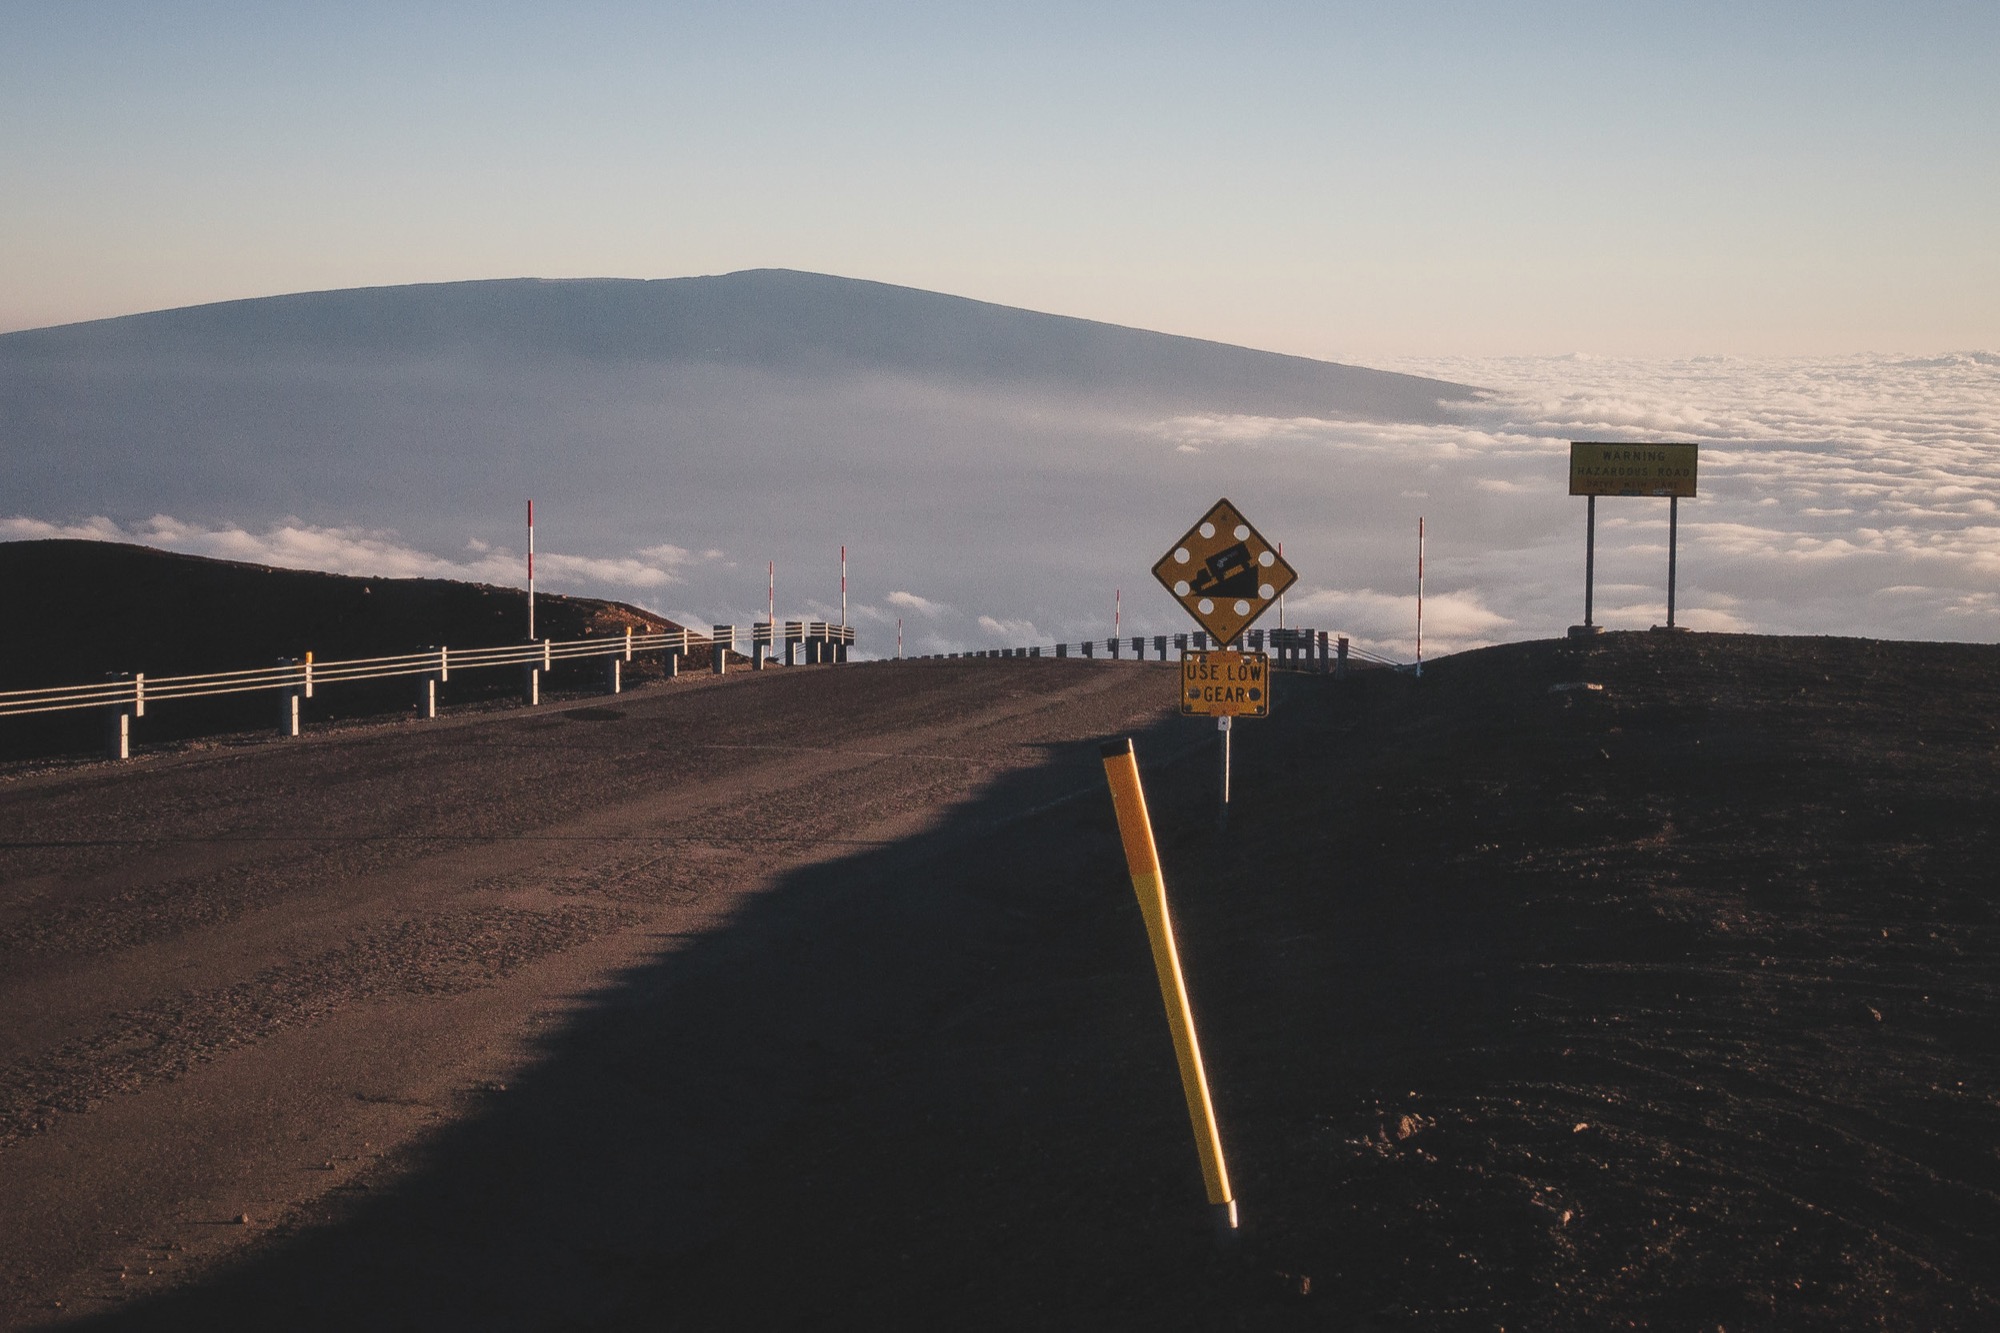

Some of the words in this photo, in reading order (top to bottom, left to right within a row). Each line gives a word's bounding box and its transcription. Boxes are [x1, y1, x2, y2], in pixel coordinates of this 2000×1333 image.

[1603, 451, 1665, 461] WARNING
[1577, 466, 1649, 477] HAZARDOUS
[1658, 467, 1690, 477] ROAD
[1187, 664, 1219, 680] USE
[1227, 665, 1261, 681] LOW
[1203, 686, 1245, 702] GEAR
